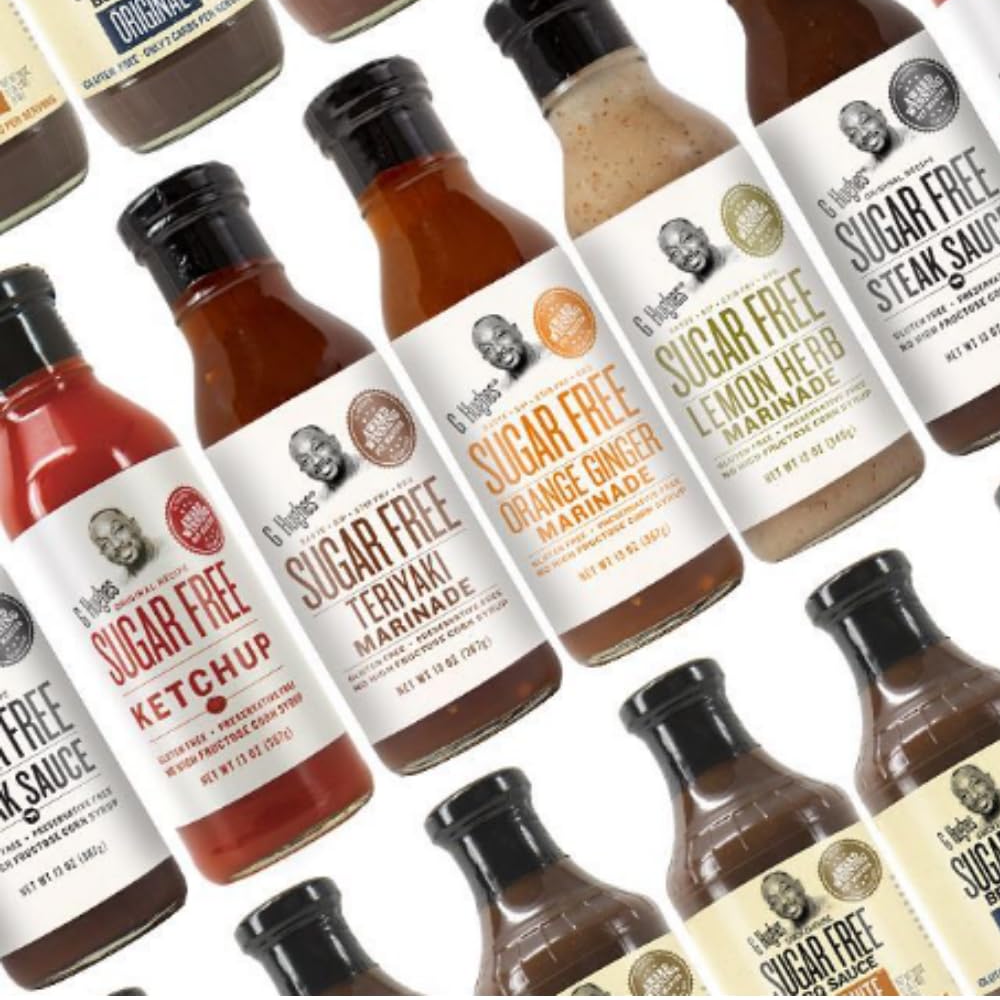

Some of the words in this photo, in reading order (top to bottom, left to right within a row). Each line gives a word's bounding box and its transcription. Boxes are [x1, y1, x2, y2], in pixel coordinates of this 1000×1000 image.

[835, 187, 935, 271] SUGAR
[920, 147, 999, 222] FREE
[867, 247, 947, 312] STEAK
[654, 308, 758, 397] SUGAR
[743, 267, 826, 345] FREE
[685, 365, 776, 438] LEMON
[774, 325, 847, 386] HERB
[723, 368, 838, 444] MARINADE
[466, 405, 572, 496] SUGAR
[557, 363, 640, 443] FREE
[497, 464, 587, 535] ORANGE
[582, 421, 664, 486] GINGER
[537, 467, 653, 541] MARINADE
[284, 518, 391, 608] SUGAR
[376, 475, 460, 556] FREE
[91, 595, 190, 684] SUGAR
[173, 560, 250, 636] FREE
[346, 551, 450, 626] TERIYAKI
[354, 578, 473, 655] MARINADE
[0, 681, 73, 756] FREE
[131, 632, 269, 728] KETCHUP
[15, 738, 95, 803] SAUCE
[760, 936, 835, 996] SUGAR
[823, 908, 881, 966] FREE
[827, 955, 877, 991] SAUCE
